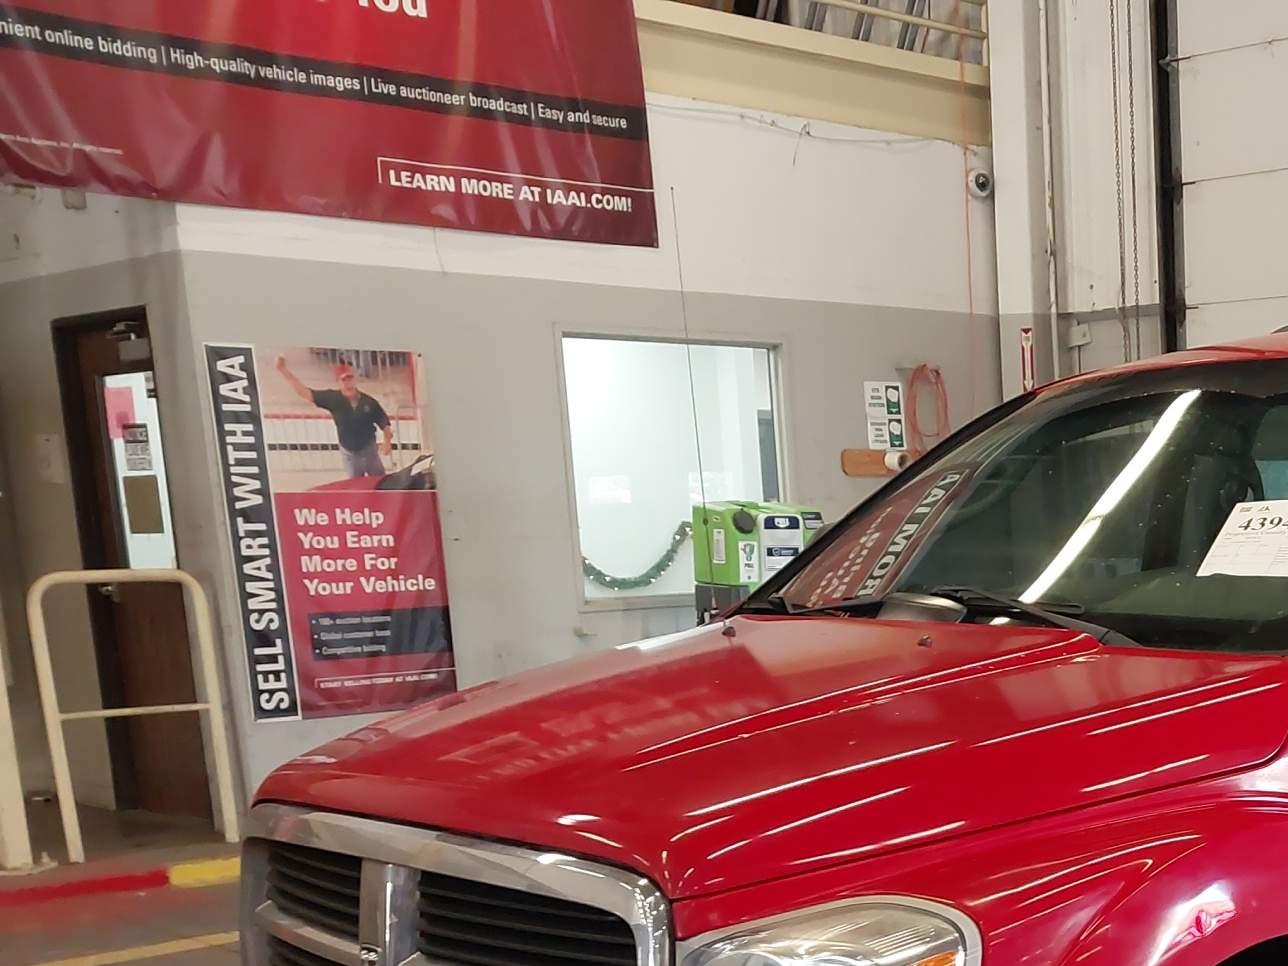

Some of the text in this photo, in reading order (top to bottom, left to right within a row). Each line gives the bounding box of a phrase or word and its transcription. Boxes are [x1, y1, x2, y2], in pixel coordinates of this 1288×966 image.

[45, 29, 94, 51] online
[98, 36, 157, 63] bidding
[170, 48, 256, 79] High-quality
[258, 65, 307, 83] vehicle
[310, 69, 360, 91] images
[371, 78, 396, 95] Live
[399, 85, 466, 106] auctioneer
[469, 92, 528, 116] broadcast
[538, 103, 564, 124] Easy
[567, 109, 590, 124] and
[591, 113, 628, 129] secure
[390, 170, 632, 212] LEARN MORE AT IAAI.COM!
[294, 507, 384, 528] We Help
[216, 355, 289, 711] SELL SMART WITH IAA
[297, 531, 394, 549] You Earn
[301, 553, 398, 572] More For
[303, 574, 436, 596] Your Vehicle
